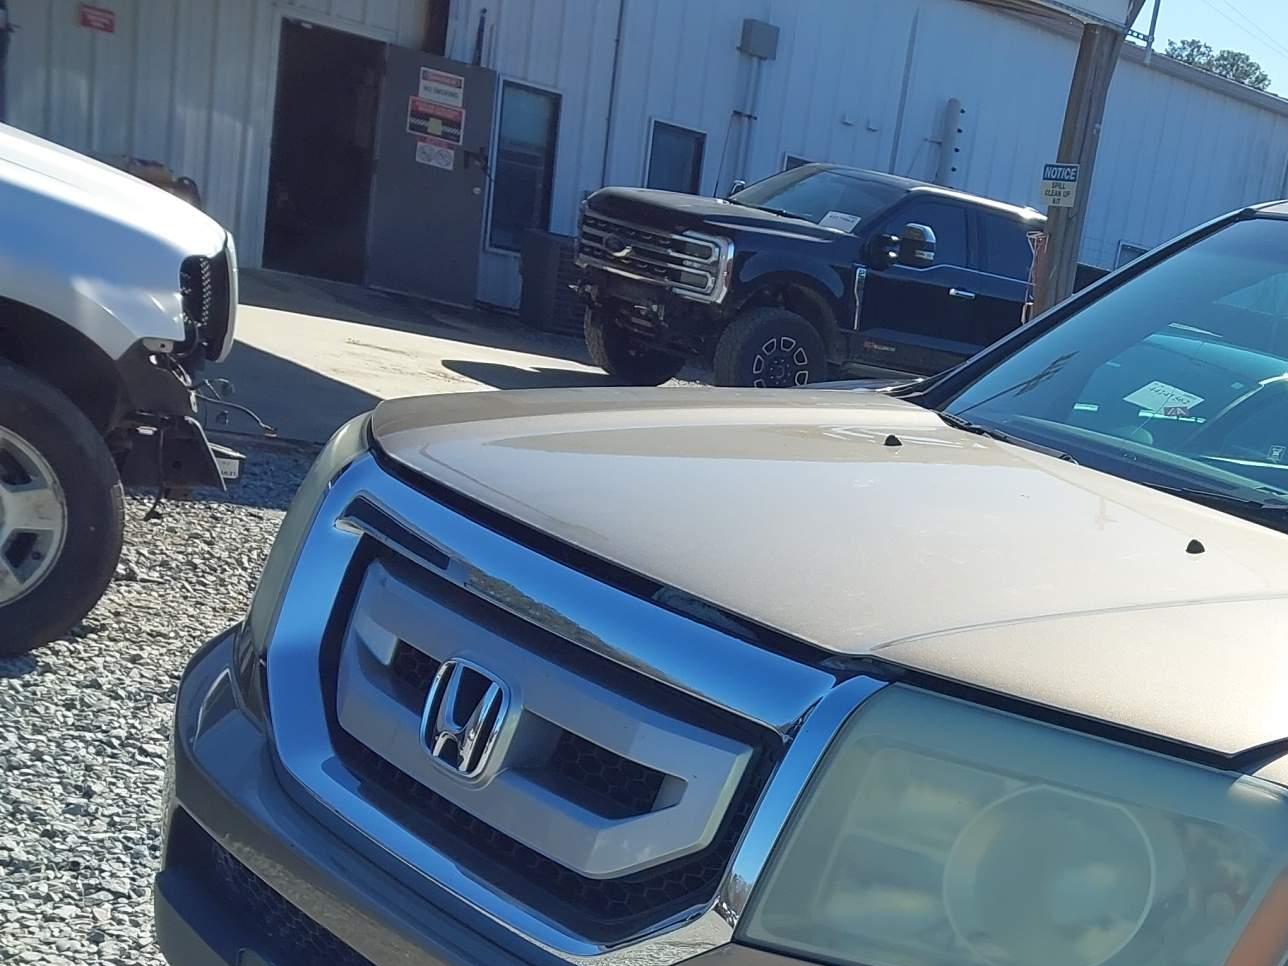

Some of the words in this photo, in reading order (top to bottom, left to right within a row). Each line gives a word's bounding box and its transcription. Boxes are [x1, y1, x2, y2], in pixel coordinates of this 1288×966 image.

[1044, 167, 1077, 180] NOTICE
[1045, 189, 1062, 197] CLEAN
[1062, 190, 1071, 198] UP
